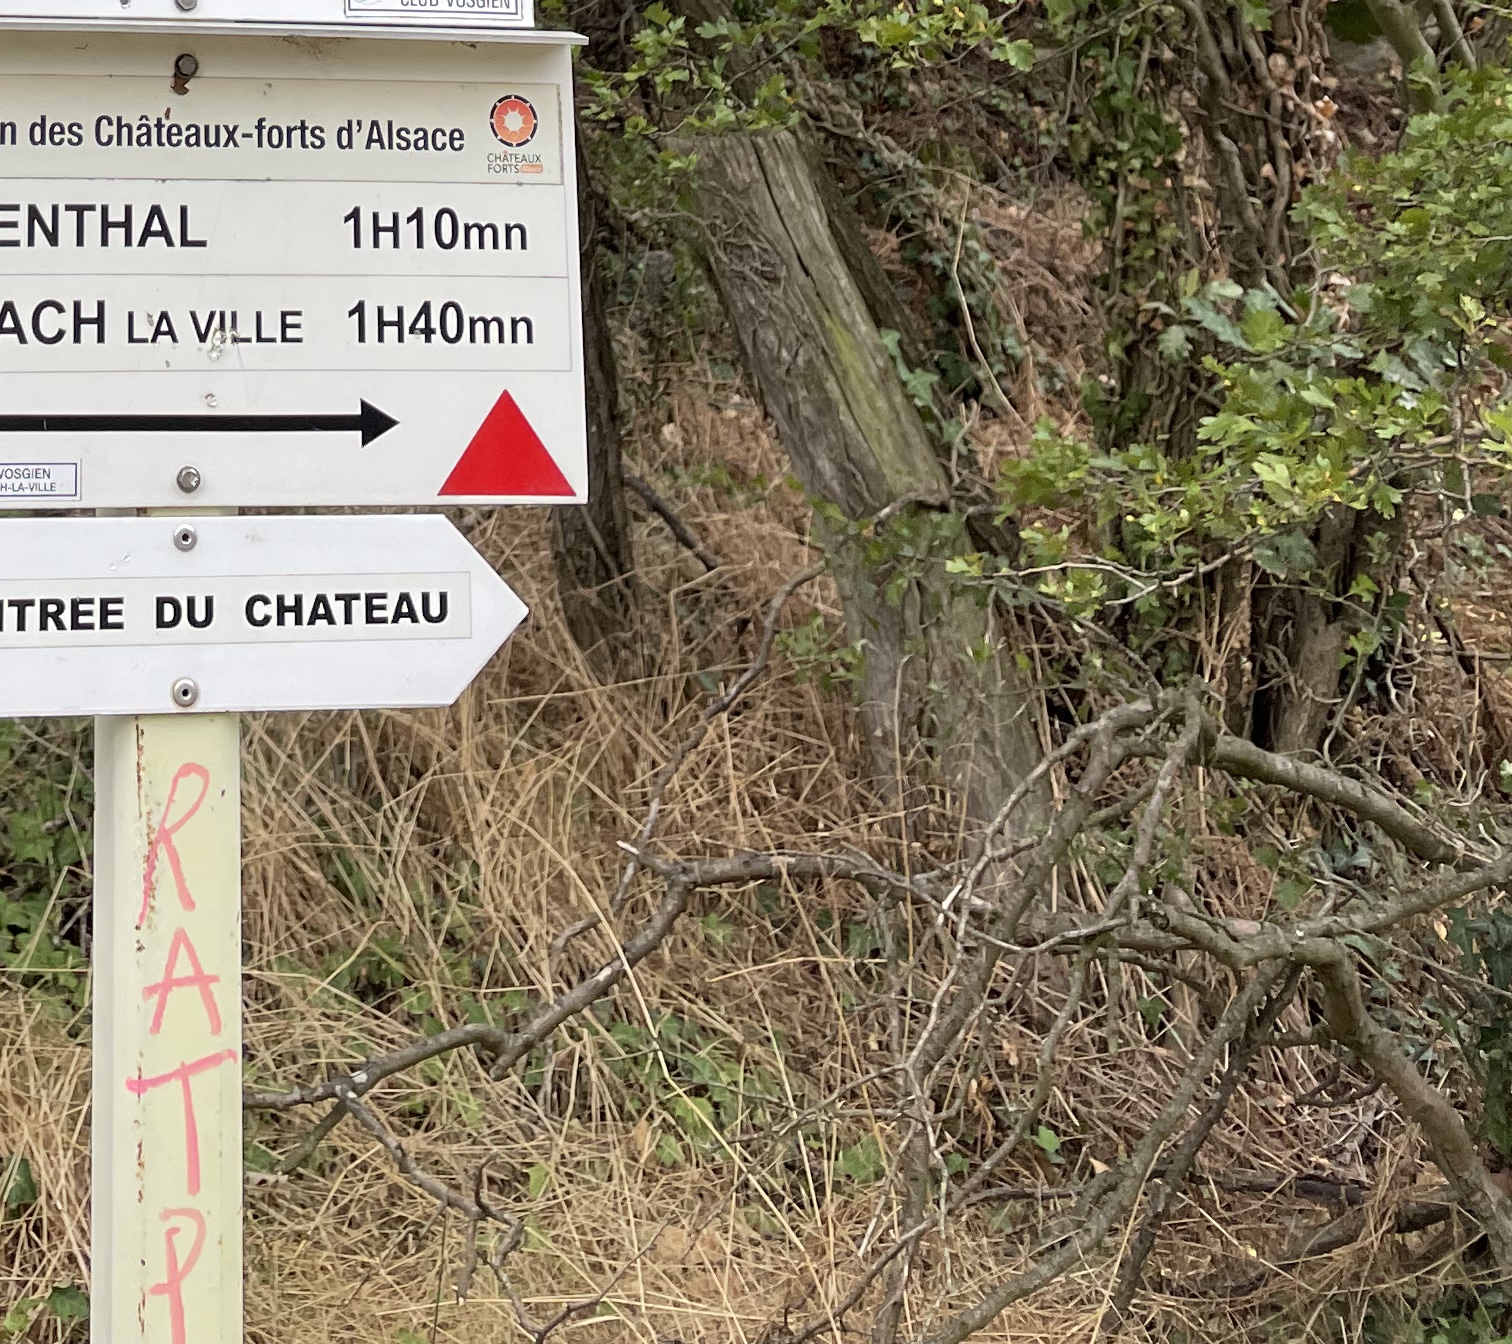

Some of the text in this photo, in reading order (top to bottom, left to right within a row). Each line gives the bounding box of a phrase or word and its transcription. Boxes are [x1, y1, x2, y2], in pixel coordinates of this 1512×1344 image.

[29, 114, 83, 146] des
[95, 113, 326, 150] Châteaux-forts
[336, 119, 465, 152] d'Alsace
[488, 164, 520, 173] FORTS
[343, 205, 528, 251] 1H10mn
[127, 310, 177, 344] LA
[189, 309, 303, 344] VILLE
[348, 300, 534, 345] 1H40mn
[154, 595, 215, 630] DU
[245, 591, 449, 628] CHATEAU
